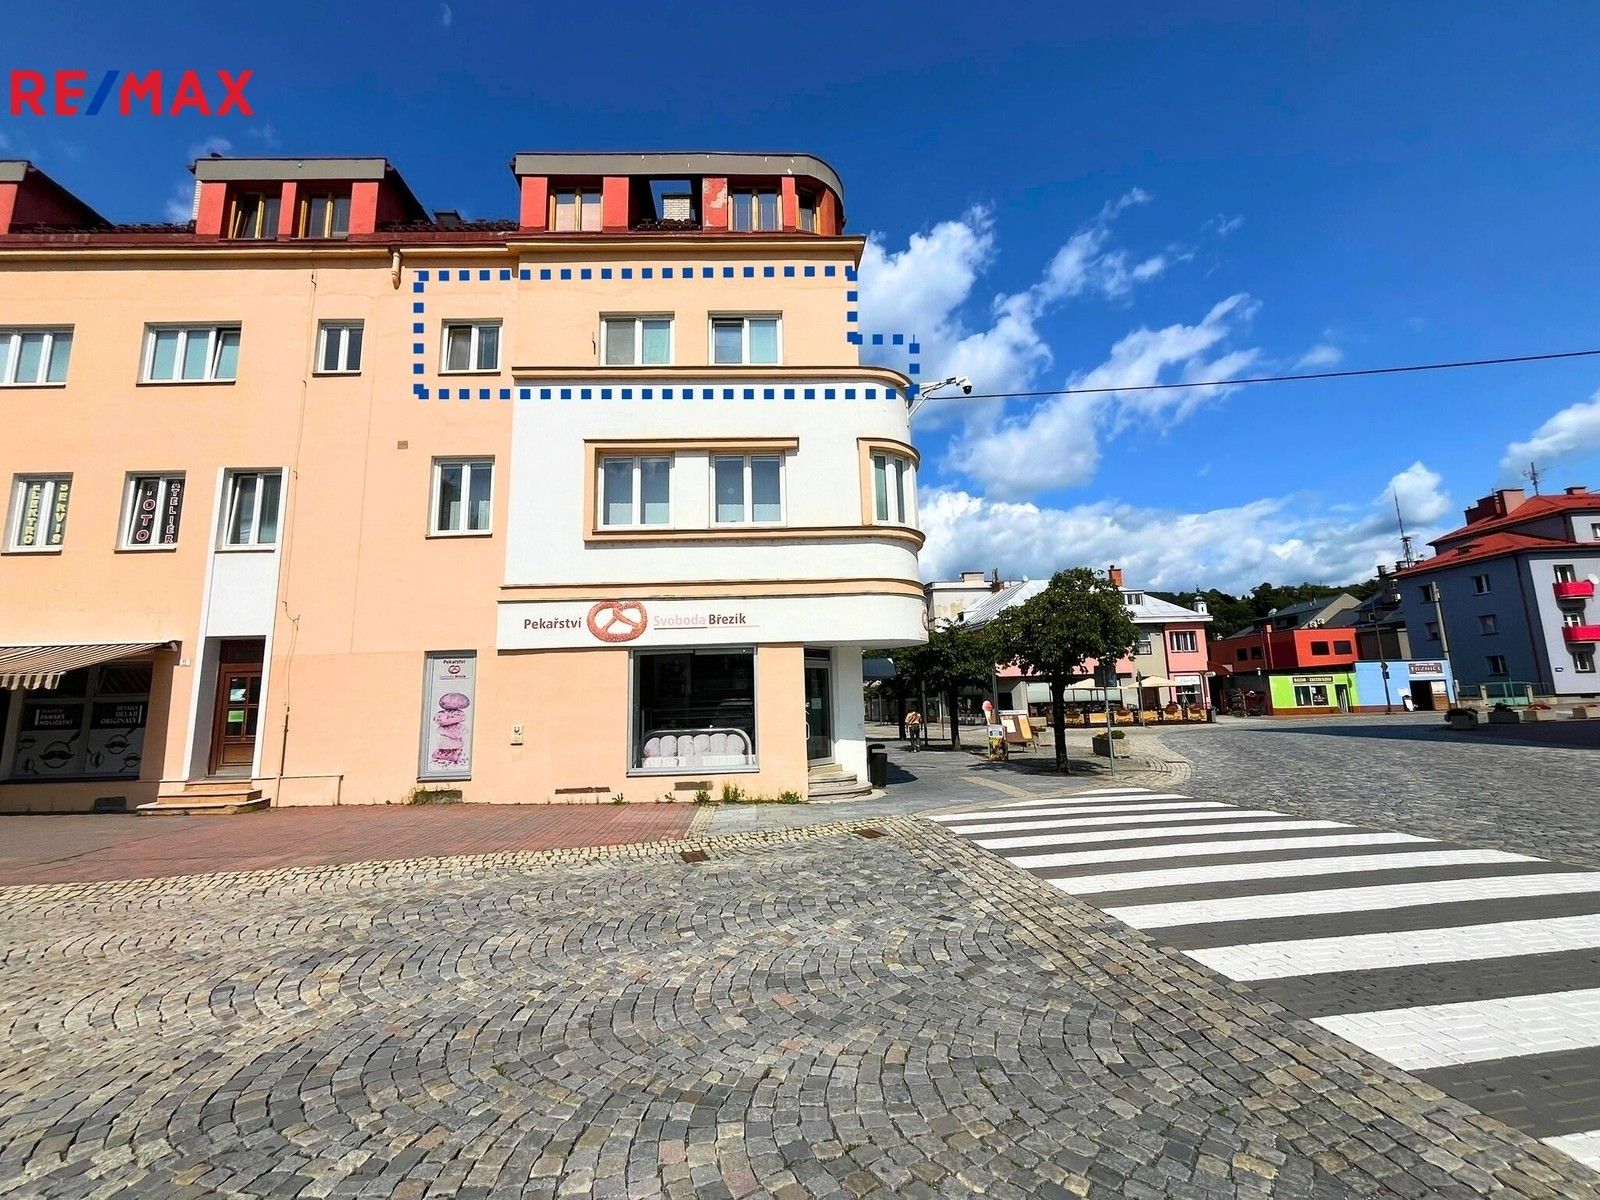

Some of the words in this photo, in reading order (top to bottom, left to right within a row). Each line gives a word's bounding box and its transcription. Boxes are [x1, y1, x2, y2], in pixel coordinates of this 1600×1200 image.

[23, 484, 41, 544] ELEKTRO
[51, 484, 69, 544] SERVIS
[164, 483, 181, 543] ATELIER
[524, 616, 582, 630] Pekařství
[653, 614, 706, 627] Svoboda
